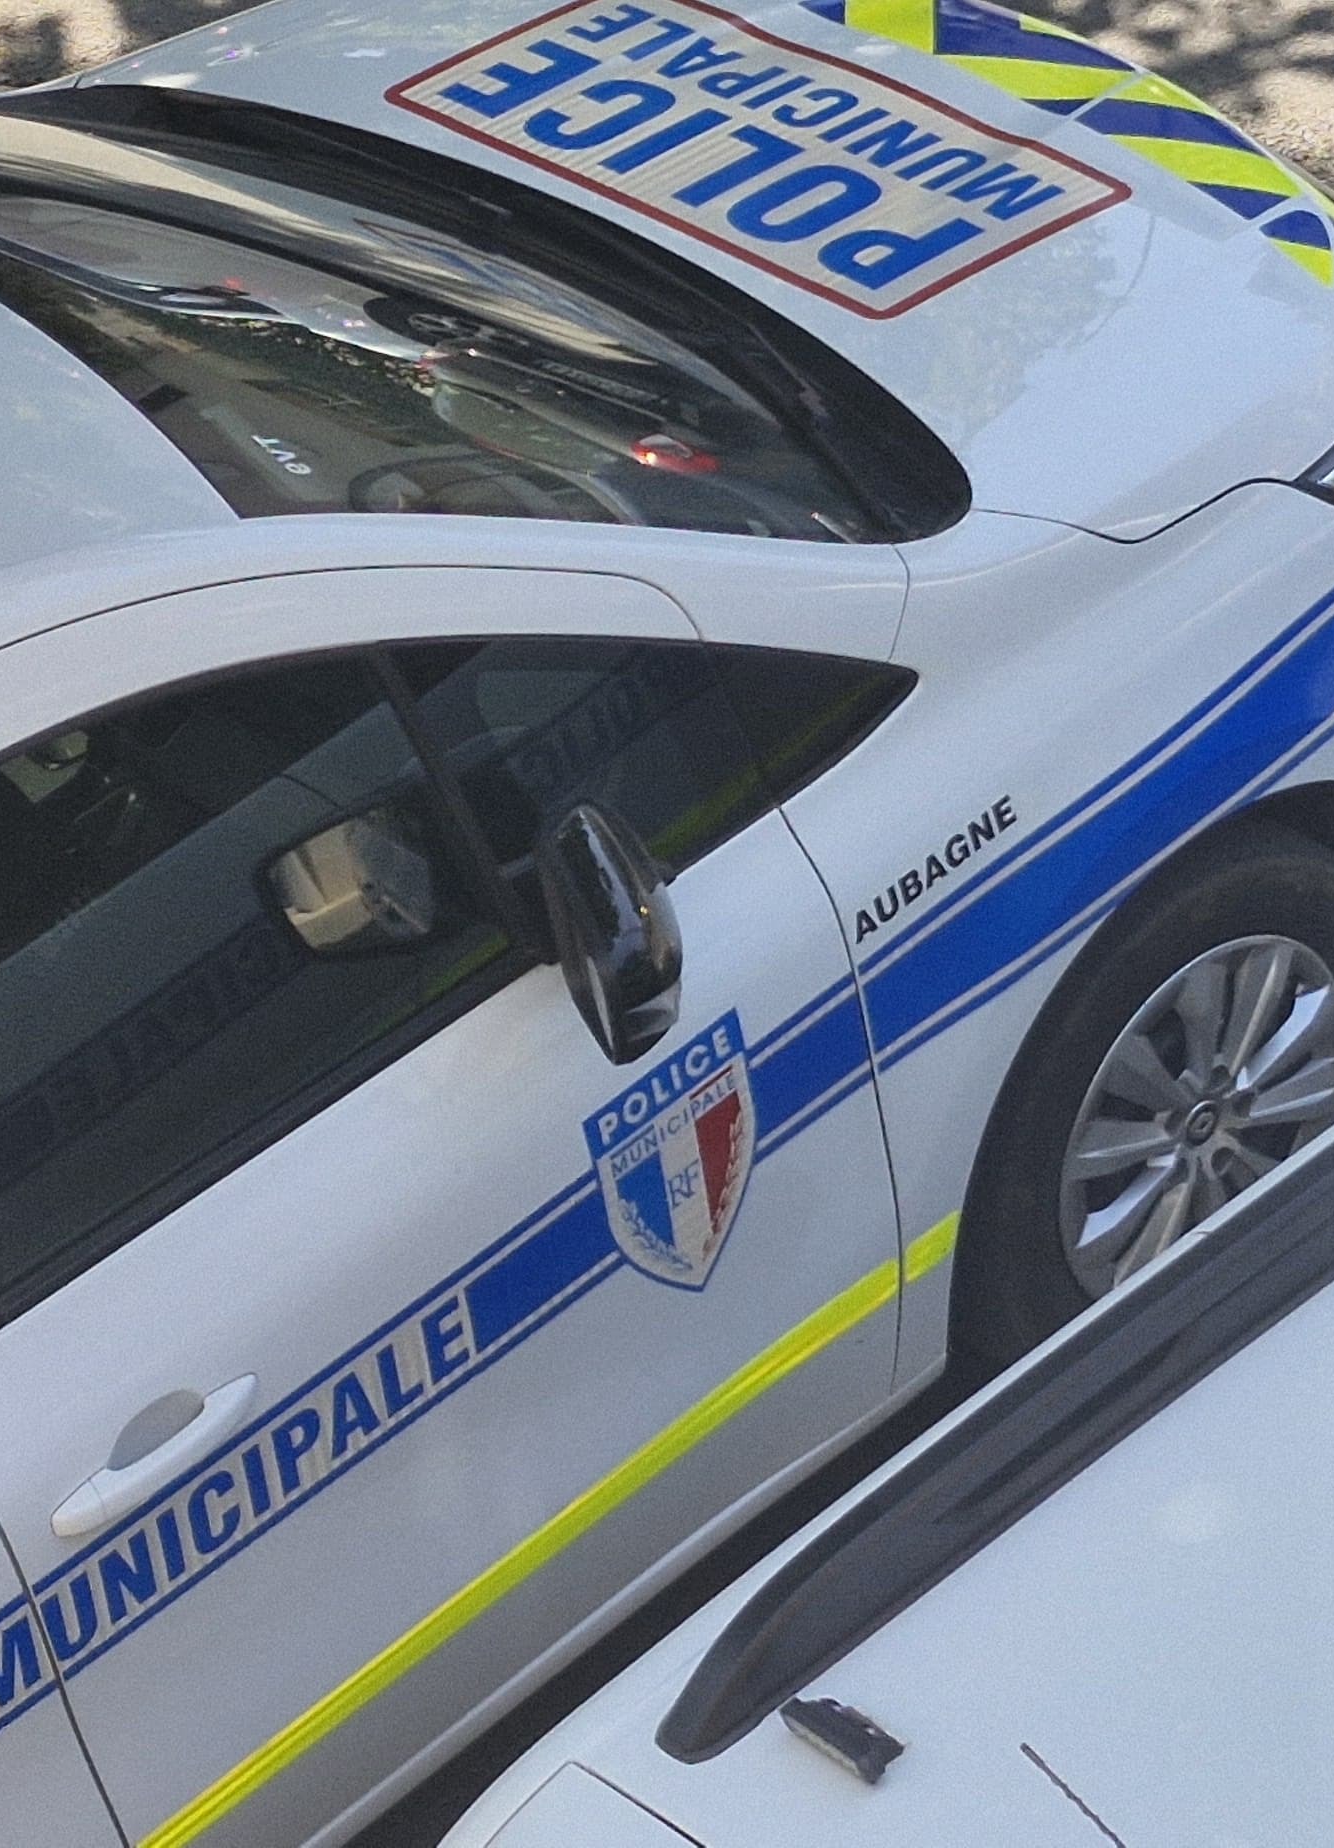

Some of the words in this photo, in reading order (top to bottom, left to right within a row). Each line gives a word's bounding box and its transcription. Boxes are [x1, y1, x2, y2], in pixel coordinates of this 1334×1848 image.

[436, 39, 985, 290] POLICE
[565, 2, 1065, 222] MUNICIPALE
[854, 796, 1018, 945] AUBAGNE
[598, 1025, 732, 1146] POLICE
[610, 1074, 735, 1179] MUNICIPALE
